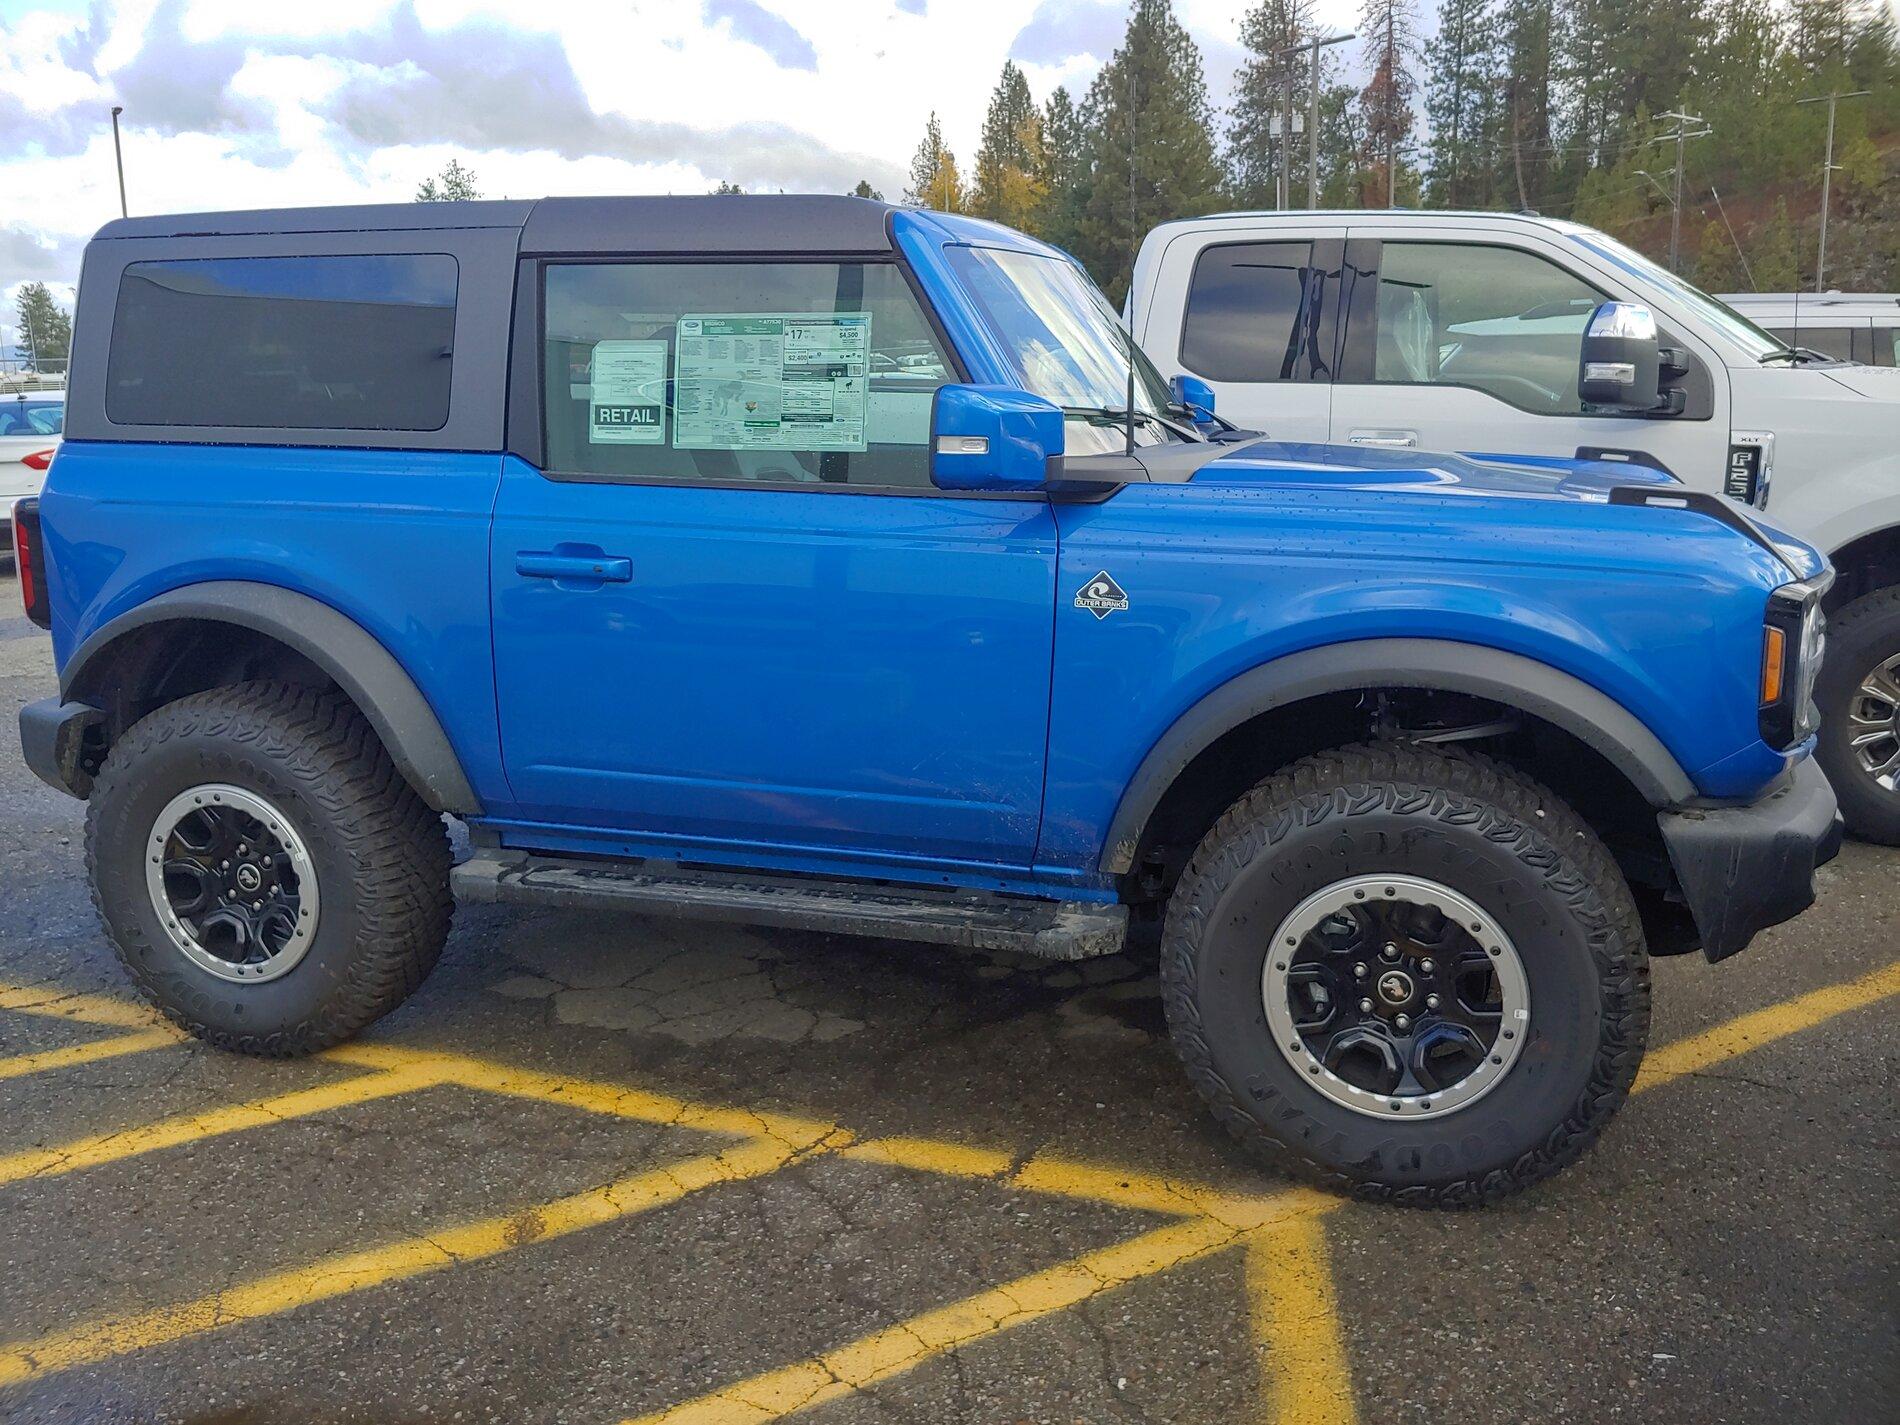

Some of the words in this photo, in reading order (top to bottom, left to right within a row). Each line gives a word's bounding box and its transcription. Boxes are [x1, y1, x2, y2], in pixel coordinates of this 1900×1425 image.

[790, 329, 803, 340] 17
[599, 408, 655, 423] RETAIL
[1076, 599, 1100, 607] OUTER
[1101, 600, 1126, 608] BANKS
